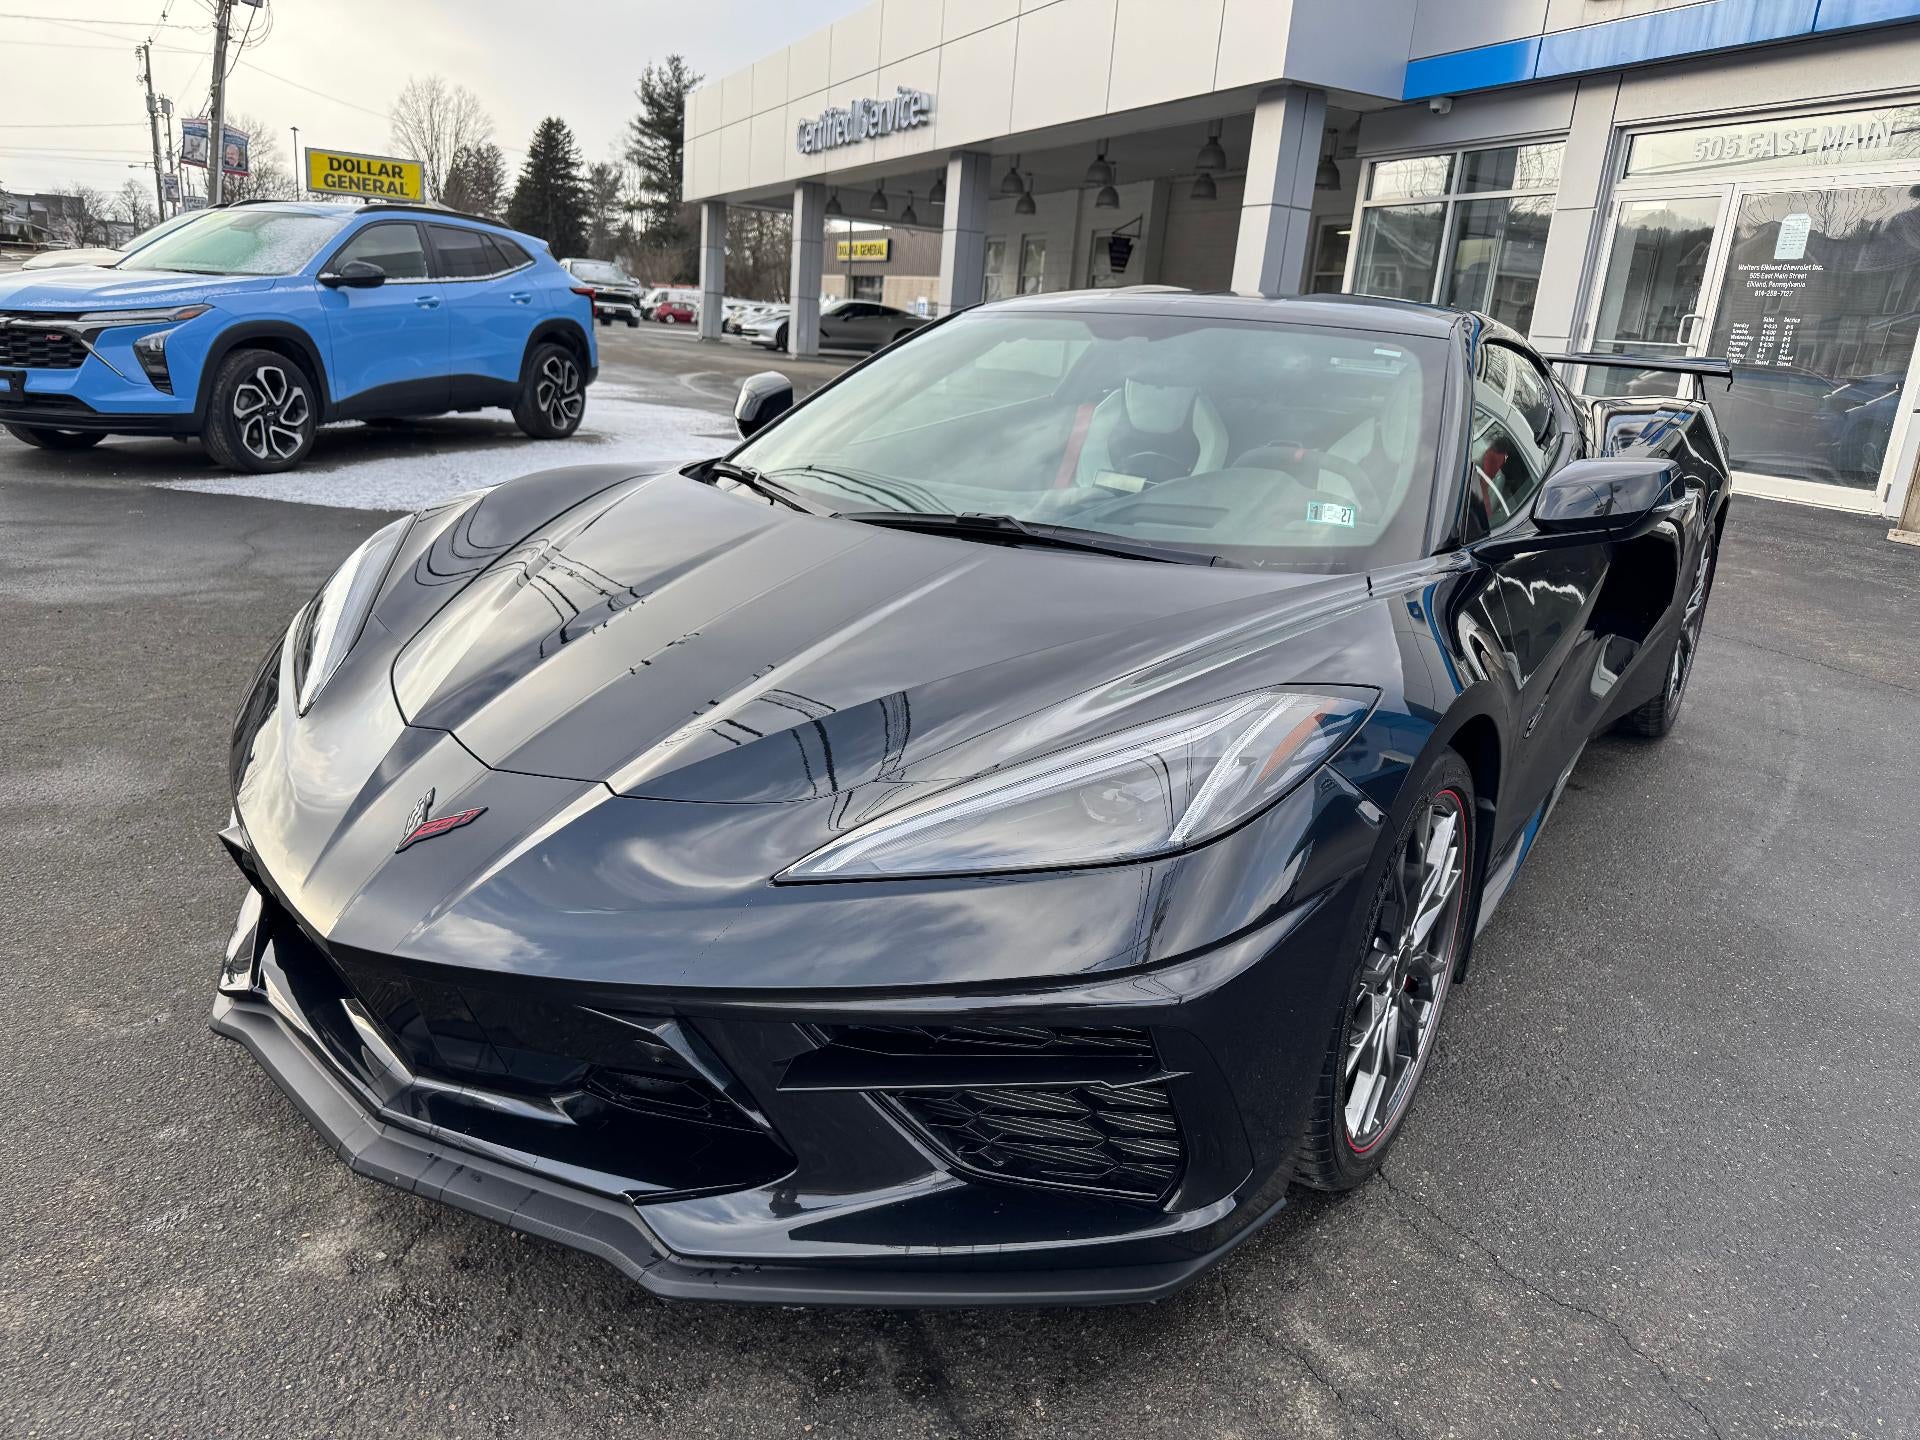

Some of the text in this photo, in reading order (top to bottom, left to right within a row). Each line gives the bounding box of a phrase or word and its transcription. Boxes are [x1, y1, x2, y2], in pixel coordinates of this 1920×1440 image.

[797, 85, 931, 154] Certified Service
[1694, 121, 1898, 161] 505 EAST MAIN
[327, 156, 404, 179] DOLLAR
[323, 173, 410, 196] GENERAL
[1341, 508, 1352, 523] 27
